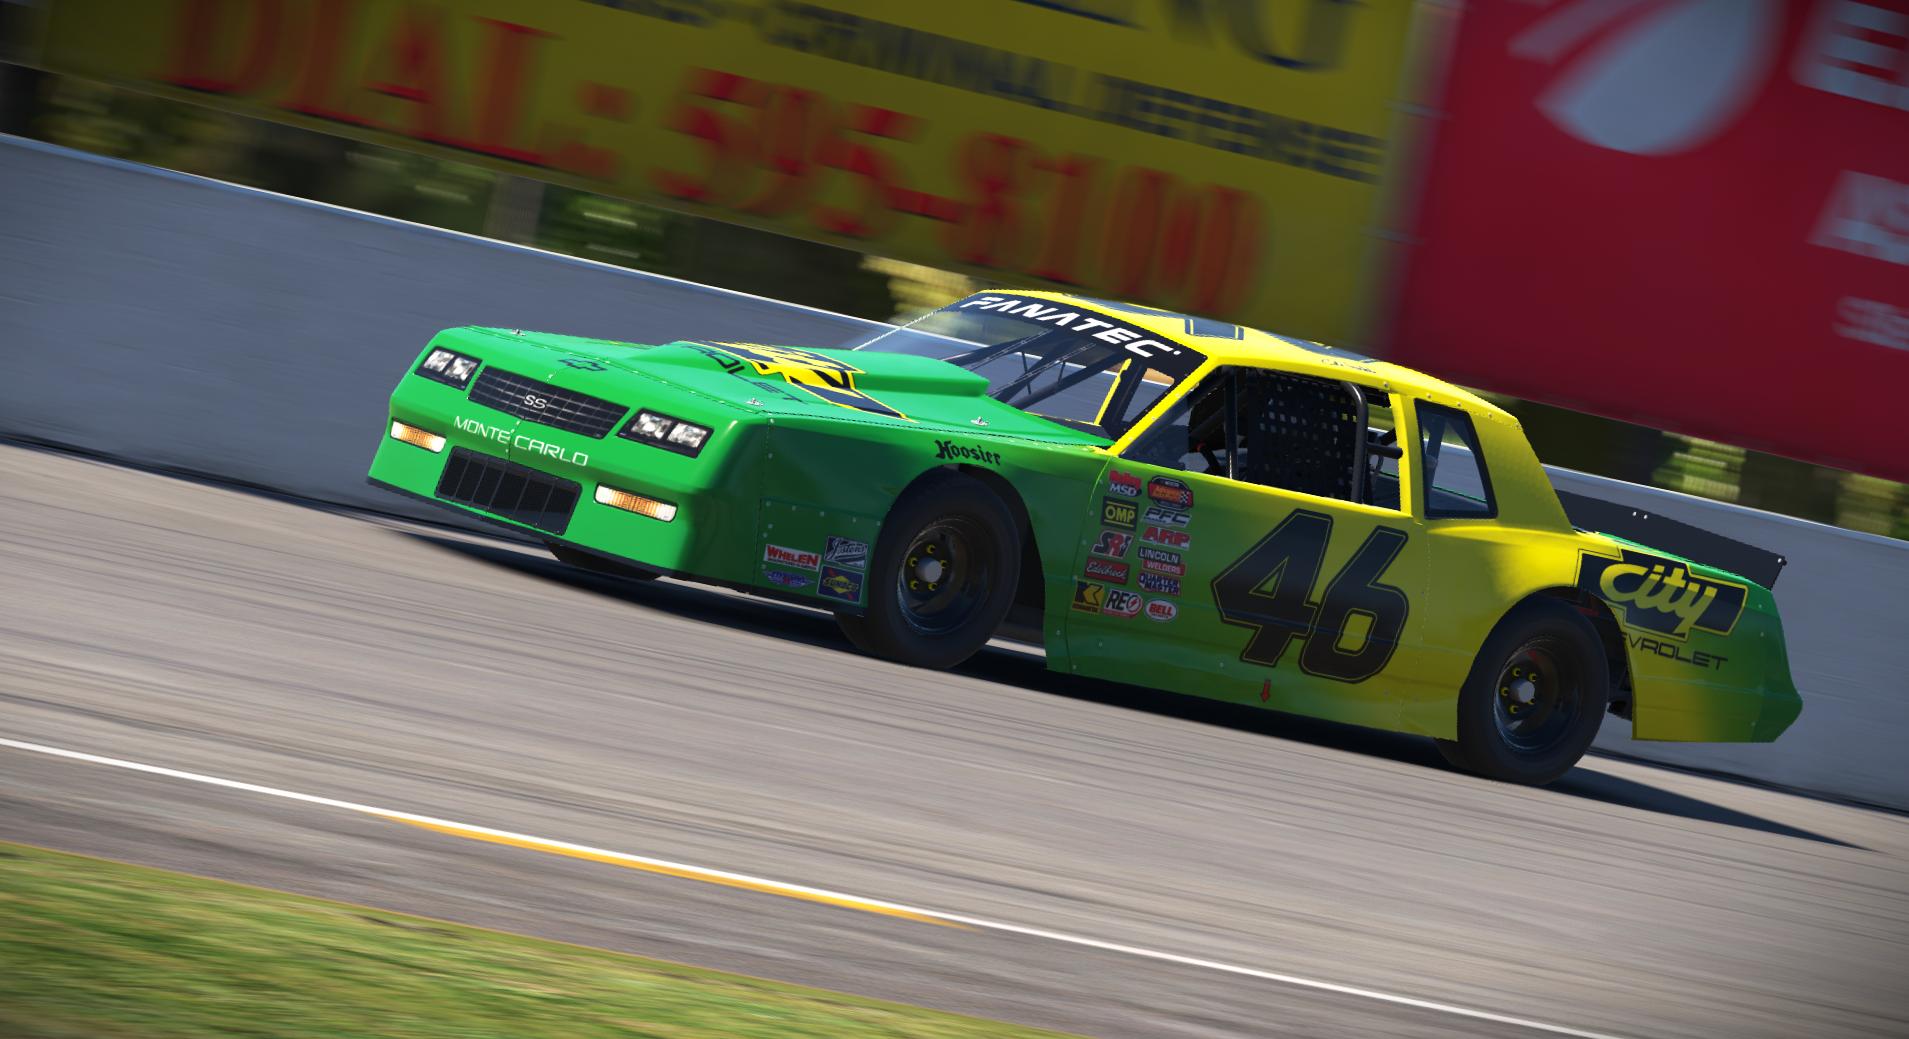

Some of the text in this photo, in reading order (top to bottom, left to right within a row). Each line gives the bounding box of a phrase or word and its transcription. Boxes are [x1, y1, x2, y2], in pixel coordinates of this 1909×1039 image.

[1098, 68, 1386, 186] DEFENSE
[959, 295, 1177, 359] FANATEC
[523, 393, 548, 410] SS
[453, 414, 589, 467] MONTE CARLO
[933, 439, 1002, 467] Hoosier
[1109, 483, 1138, 498] MSD
[1104, 505, 1136, 523] OMP
[1145, 507, 1192, 525] PFC
[767, 545, 819, 567] WHELEN
[1139, 548, 1179, 565] LINCOLN
[1145, 560, 1182, 575] WELDERS
[1209, 508, 1410, 684] 46
[1600, 562, 1719, 640] City
[1149, 602, 1174, 615] BELL
